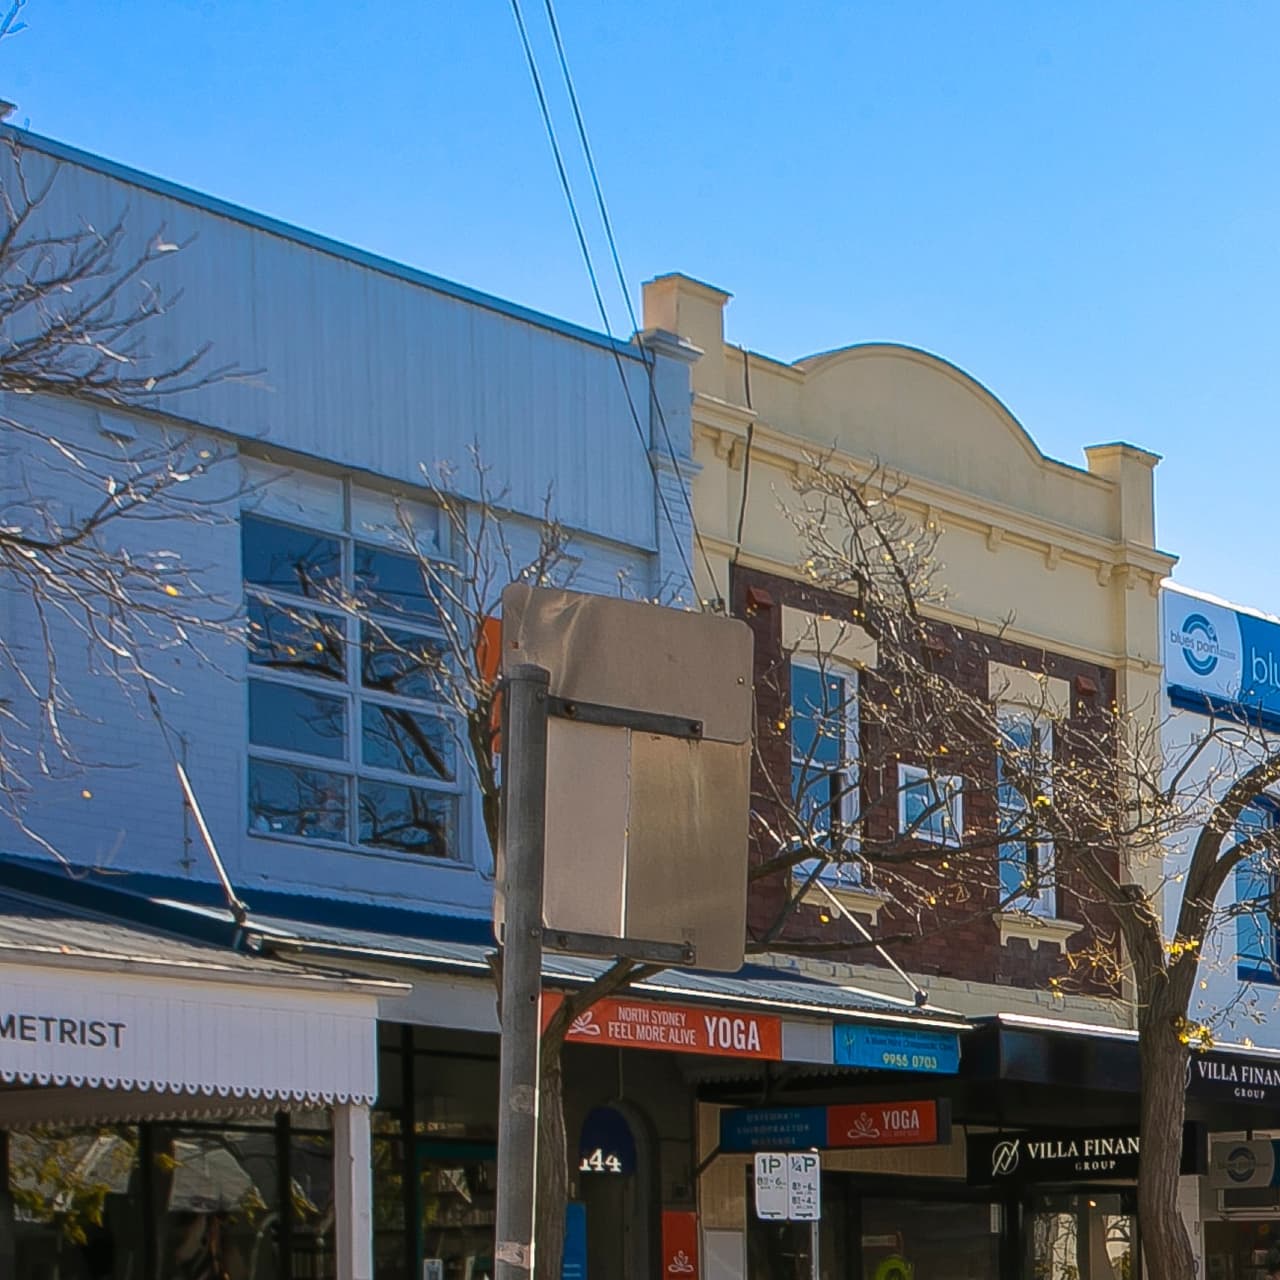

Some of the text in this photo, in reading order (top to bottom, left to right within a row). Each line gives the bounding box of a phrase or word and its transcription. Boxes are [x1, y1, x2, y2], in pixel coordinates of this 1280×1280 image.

[618, 1006, 686, 1027] NORTH SYDNEY
[608, 1021, 697, 1046] FEEL MORE ALIVE
[704, 1015, 761, 1051] YOGA
[1197, 1060, 1238, 1082] VILLA
[1234, 1087, 1265, 1099] GROUP
[882, 1109, 920, 1129] YOGA
[1027, 1136, 1141, 1159] VILLA FINAN
[1075, 1160, 1116, 1171] GROUP
